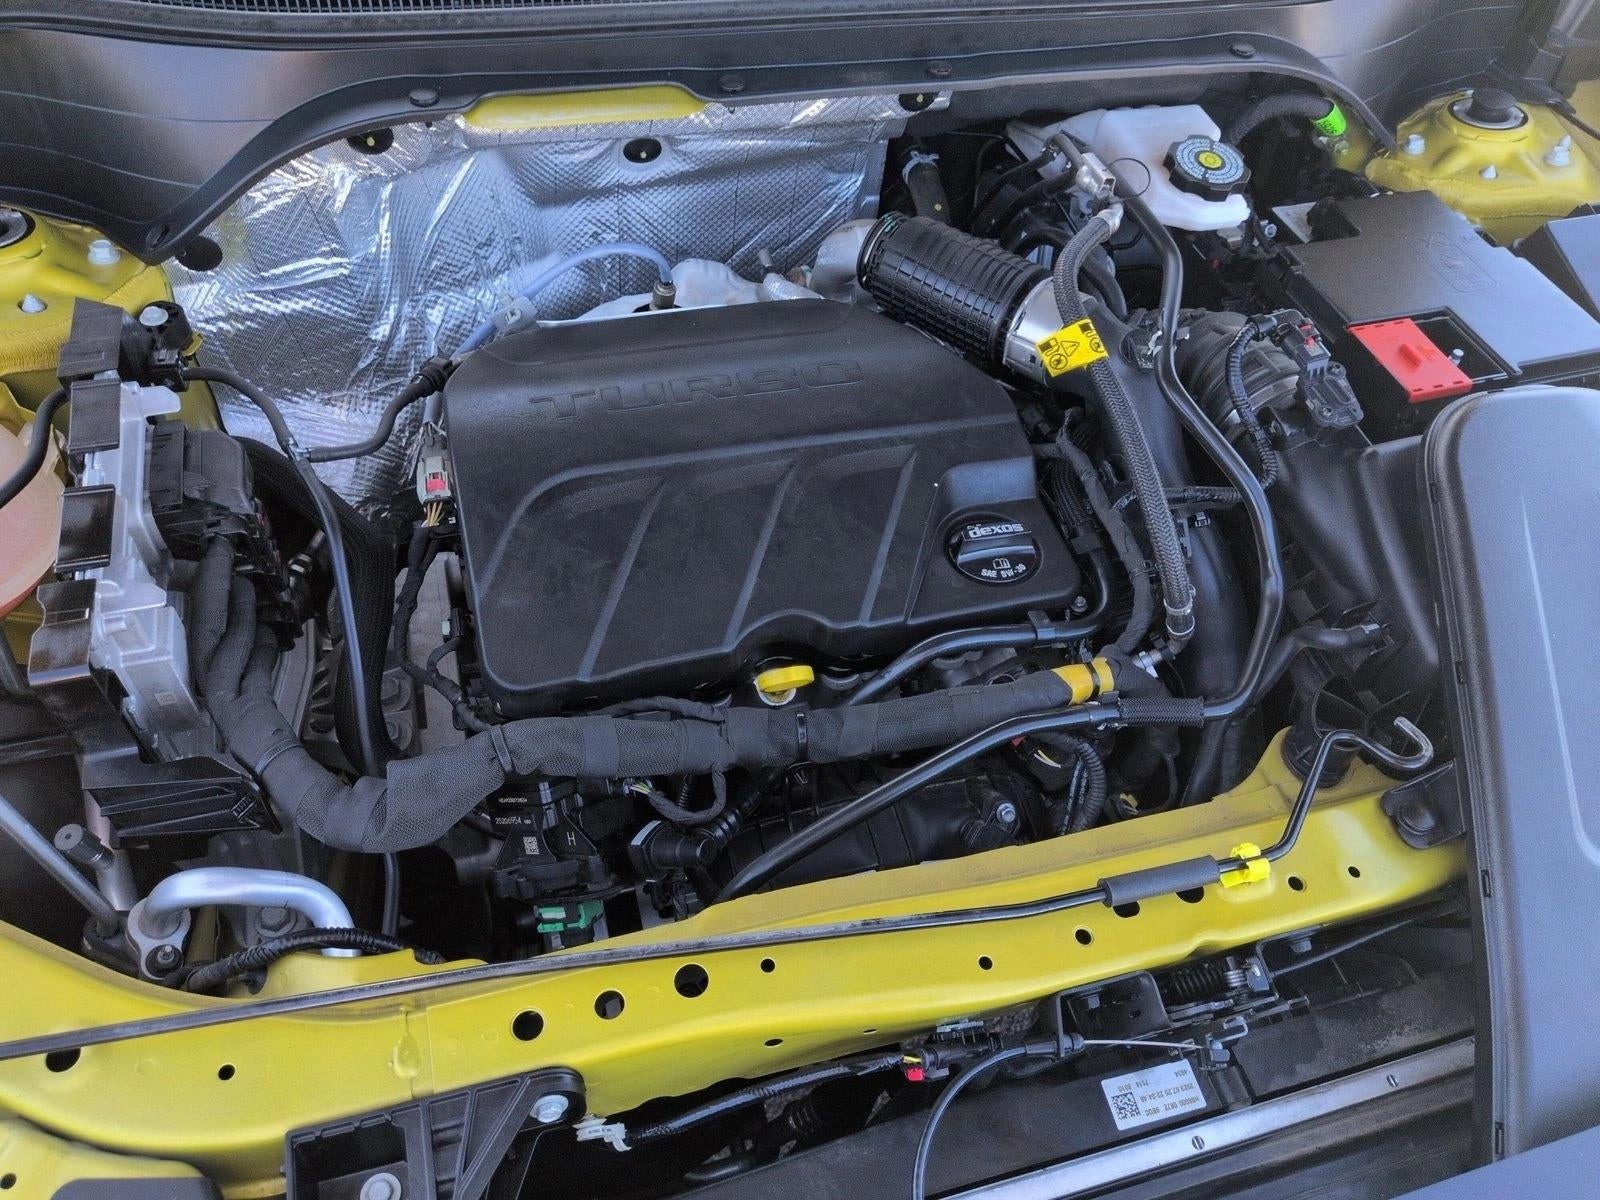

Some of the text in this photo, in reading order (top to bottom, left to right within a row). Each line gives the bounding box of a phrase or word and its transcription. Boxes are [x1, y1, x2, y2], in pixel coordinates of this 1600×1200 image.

[528, 360, 864, 421] TURBO
[967, 523, 1024, 538] dexos
[981, 568, 997, 578] SAE
